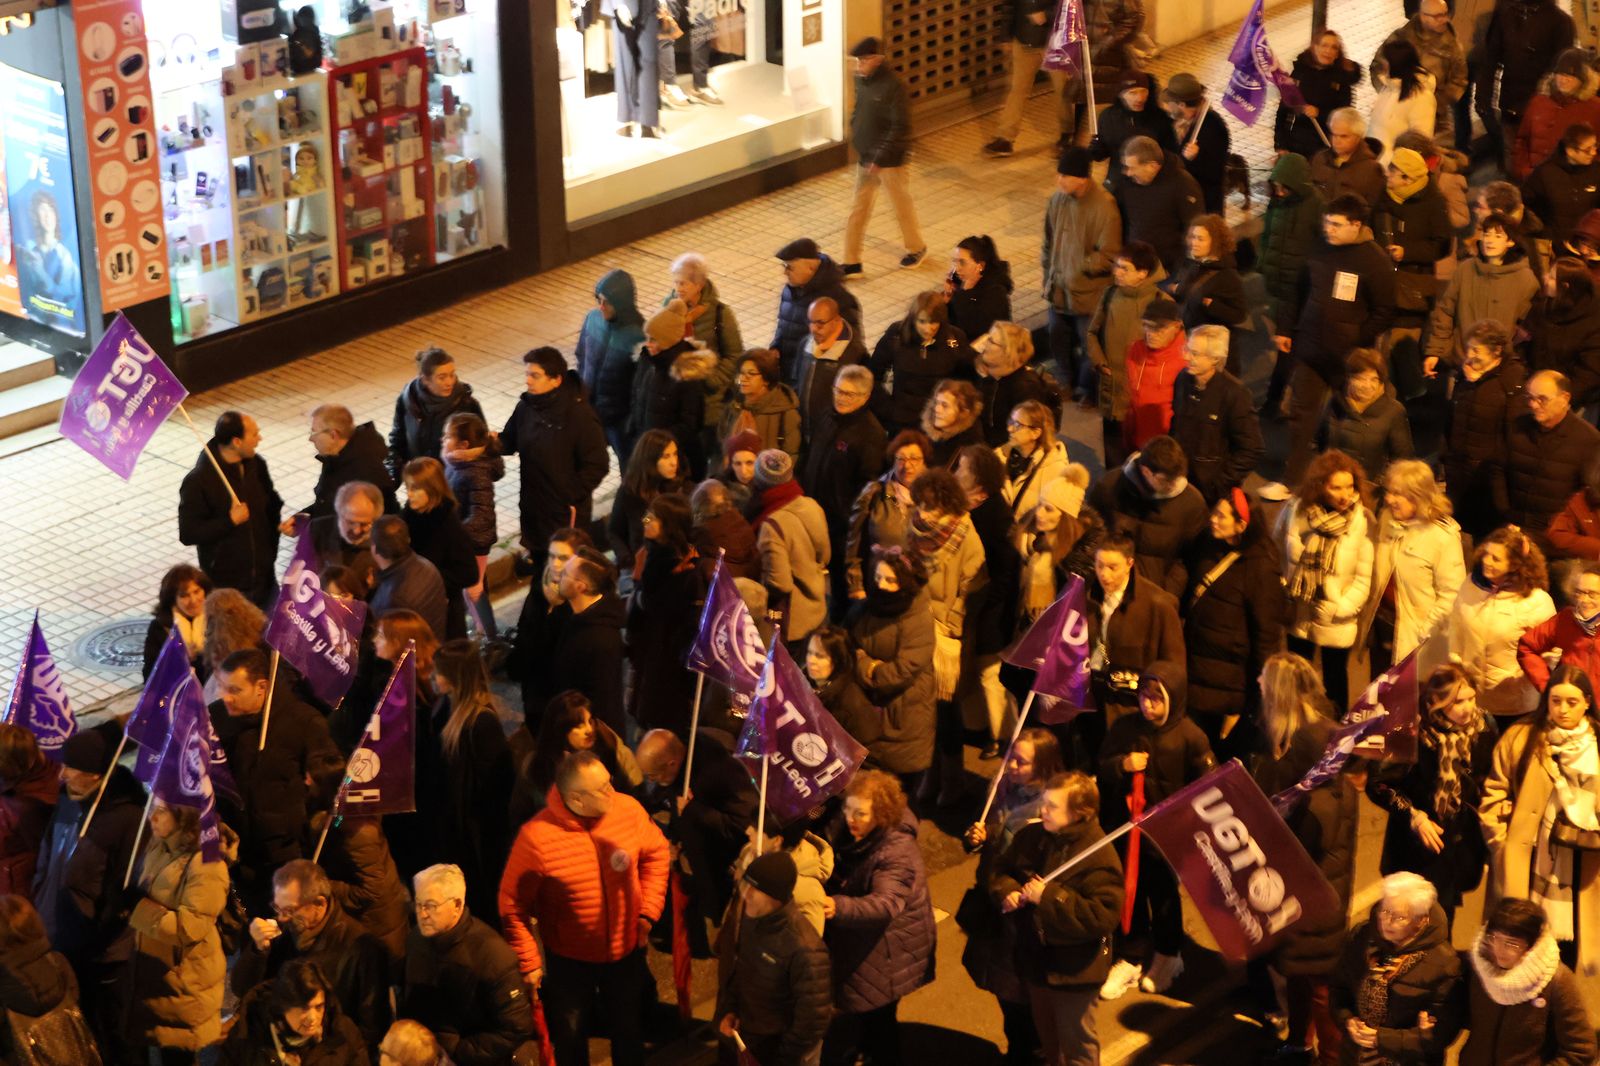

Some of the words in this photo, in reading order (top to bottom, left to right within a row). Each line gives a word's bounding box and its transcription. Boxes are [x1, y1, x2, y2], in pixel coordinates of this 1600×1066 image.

[97, 333, 156, 400] UGT
[286, 600, 317, 642] Castilla
[312, 638, 328, 653] y
[323, 646, 351, 676] León
[770, 751, 785, 765] y
[782, 759, 812, 798] León
[1191, 786, 1268, 873] UGT
